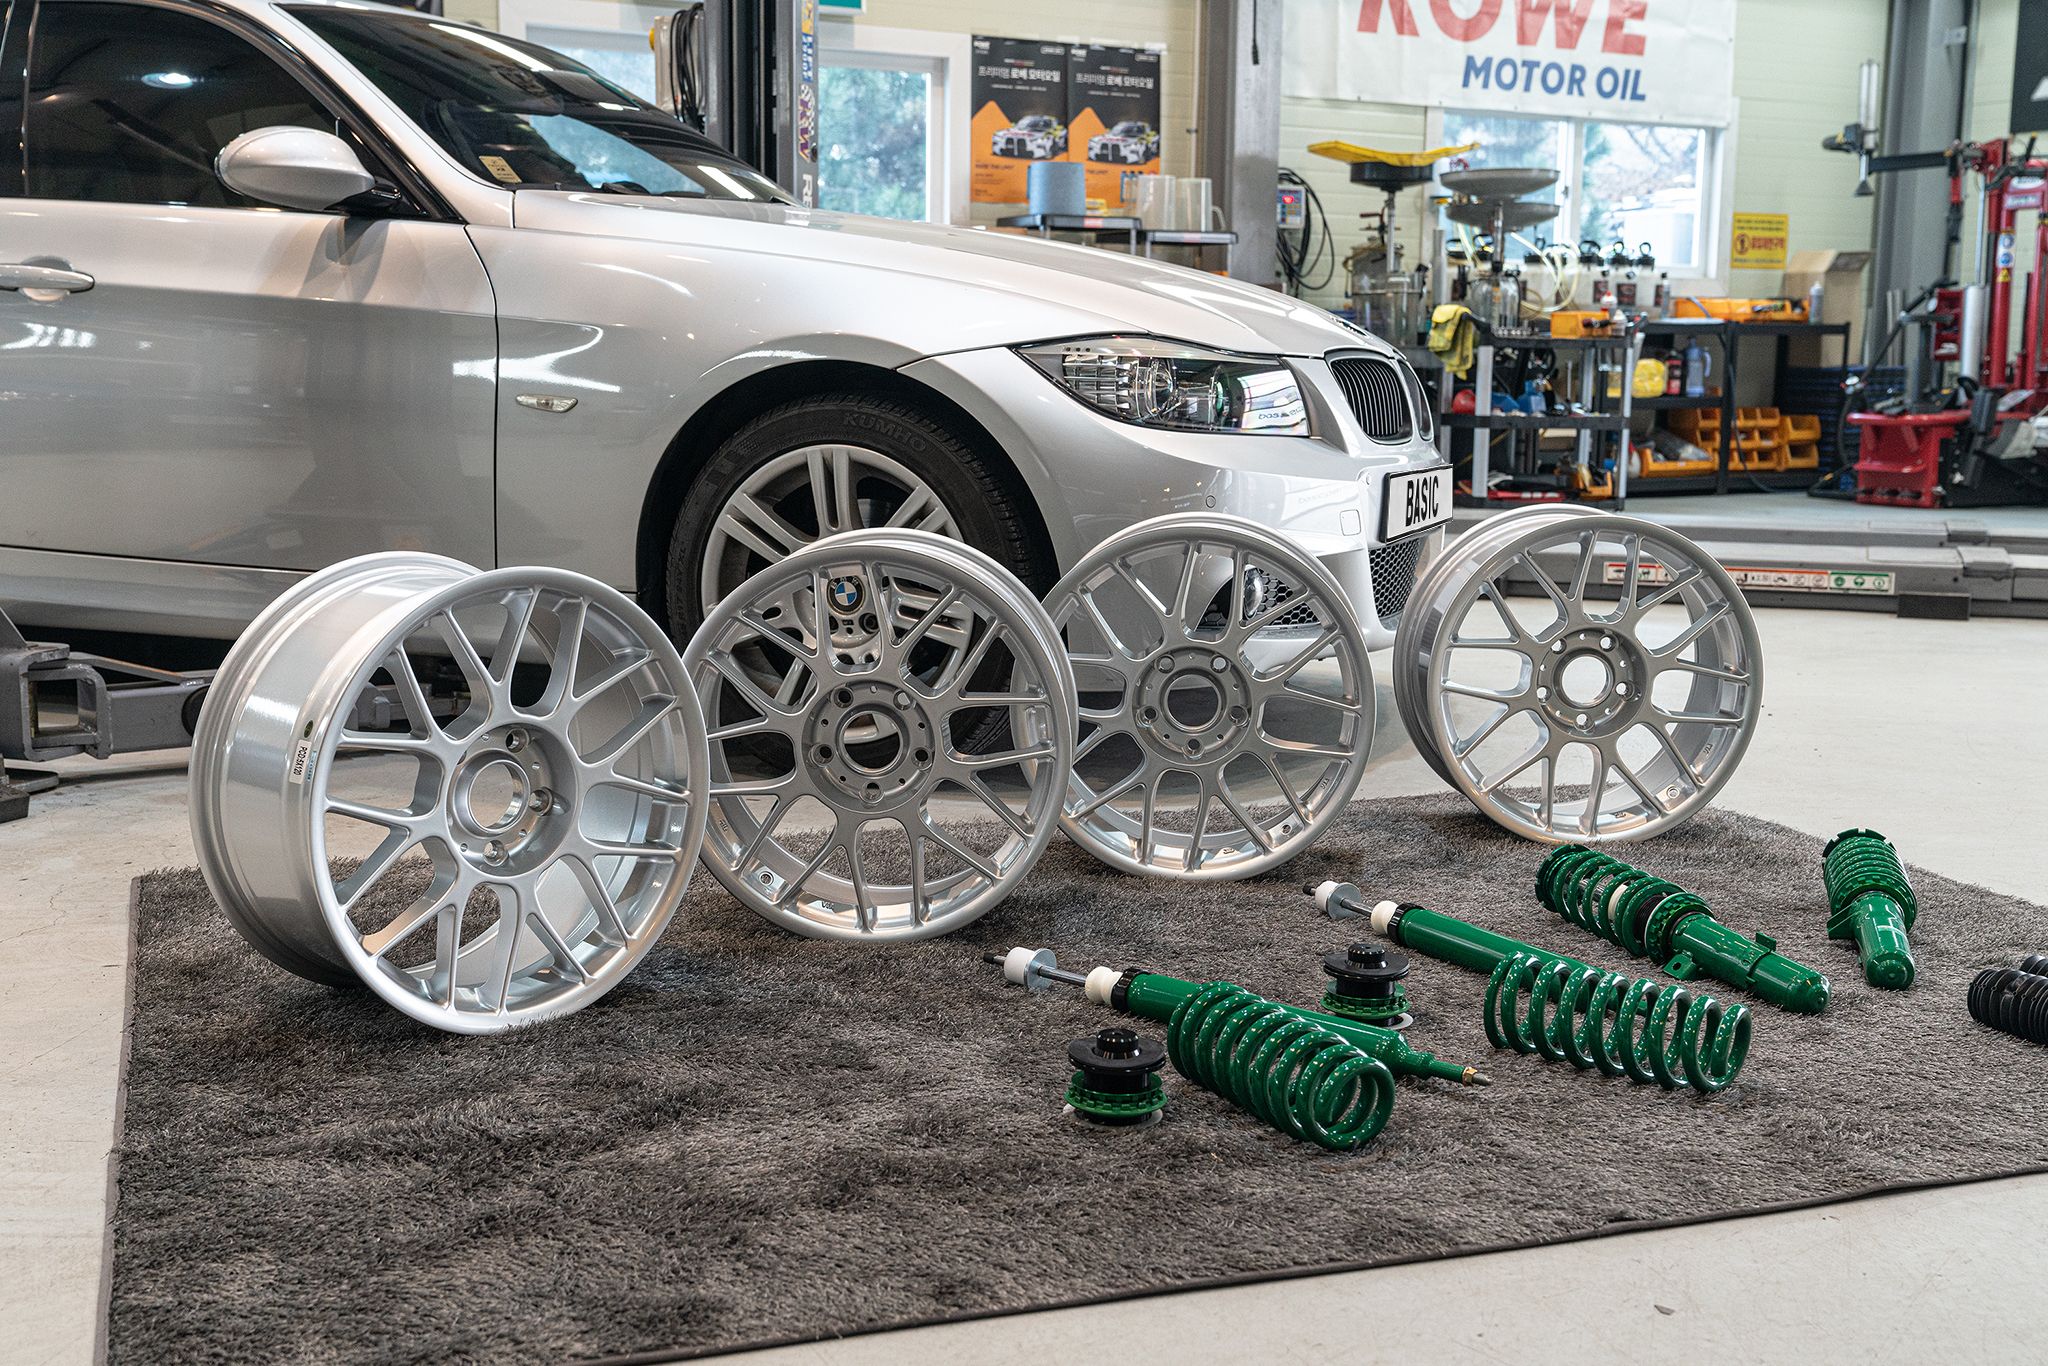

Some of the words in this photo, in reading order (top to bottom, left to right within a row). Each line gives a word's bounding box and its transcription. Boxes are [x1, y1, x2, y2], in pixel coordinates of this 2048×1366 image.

[1462, 55, 1587, 97] MOTOR
[1596, 65, 1647, 102] OIL
[845, 413, 927, 450] KUMHO
[1405, 475, 1439, 527] BASIC
